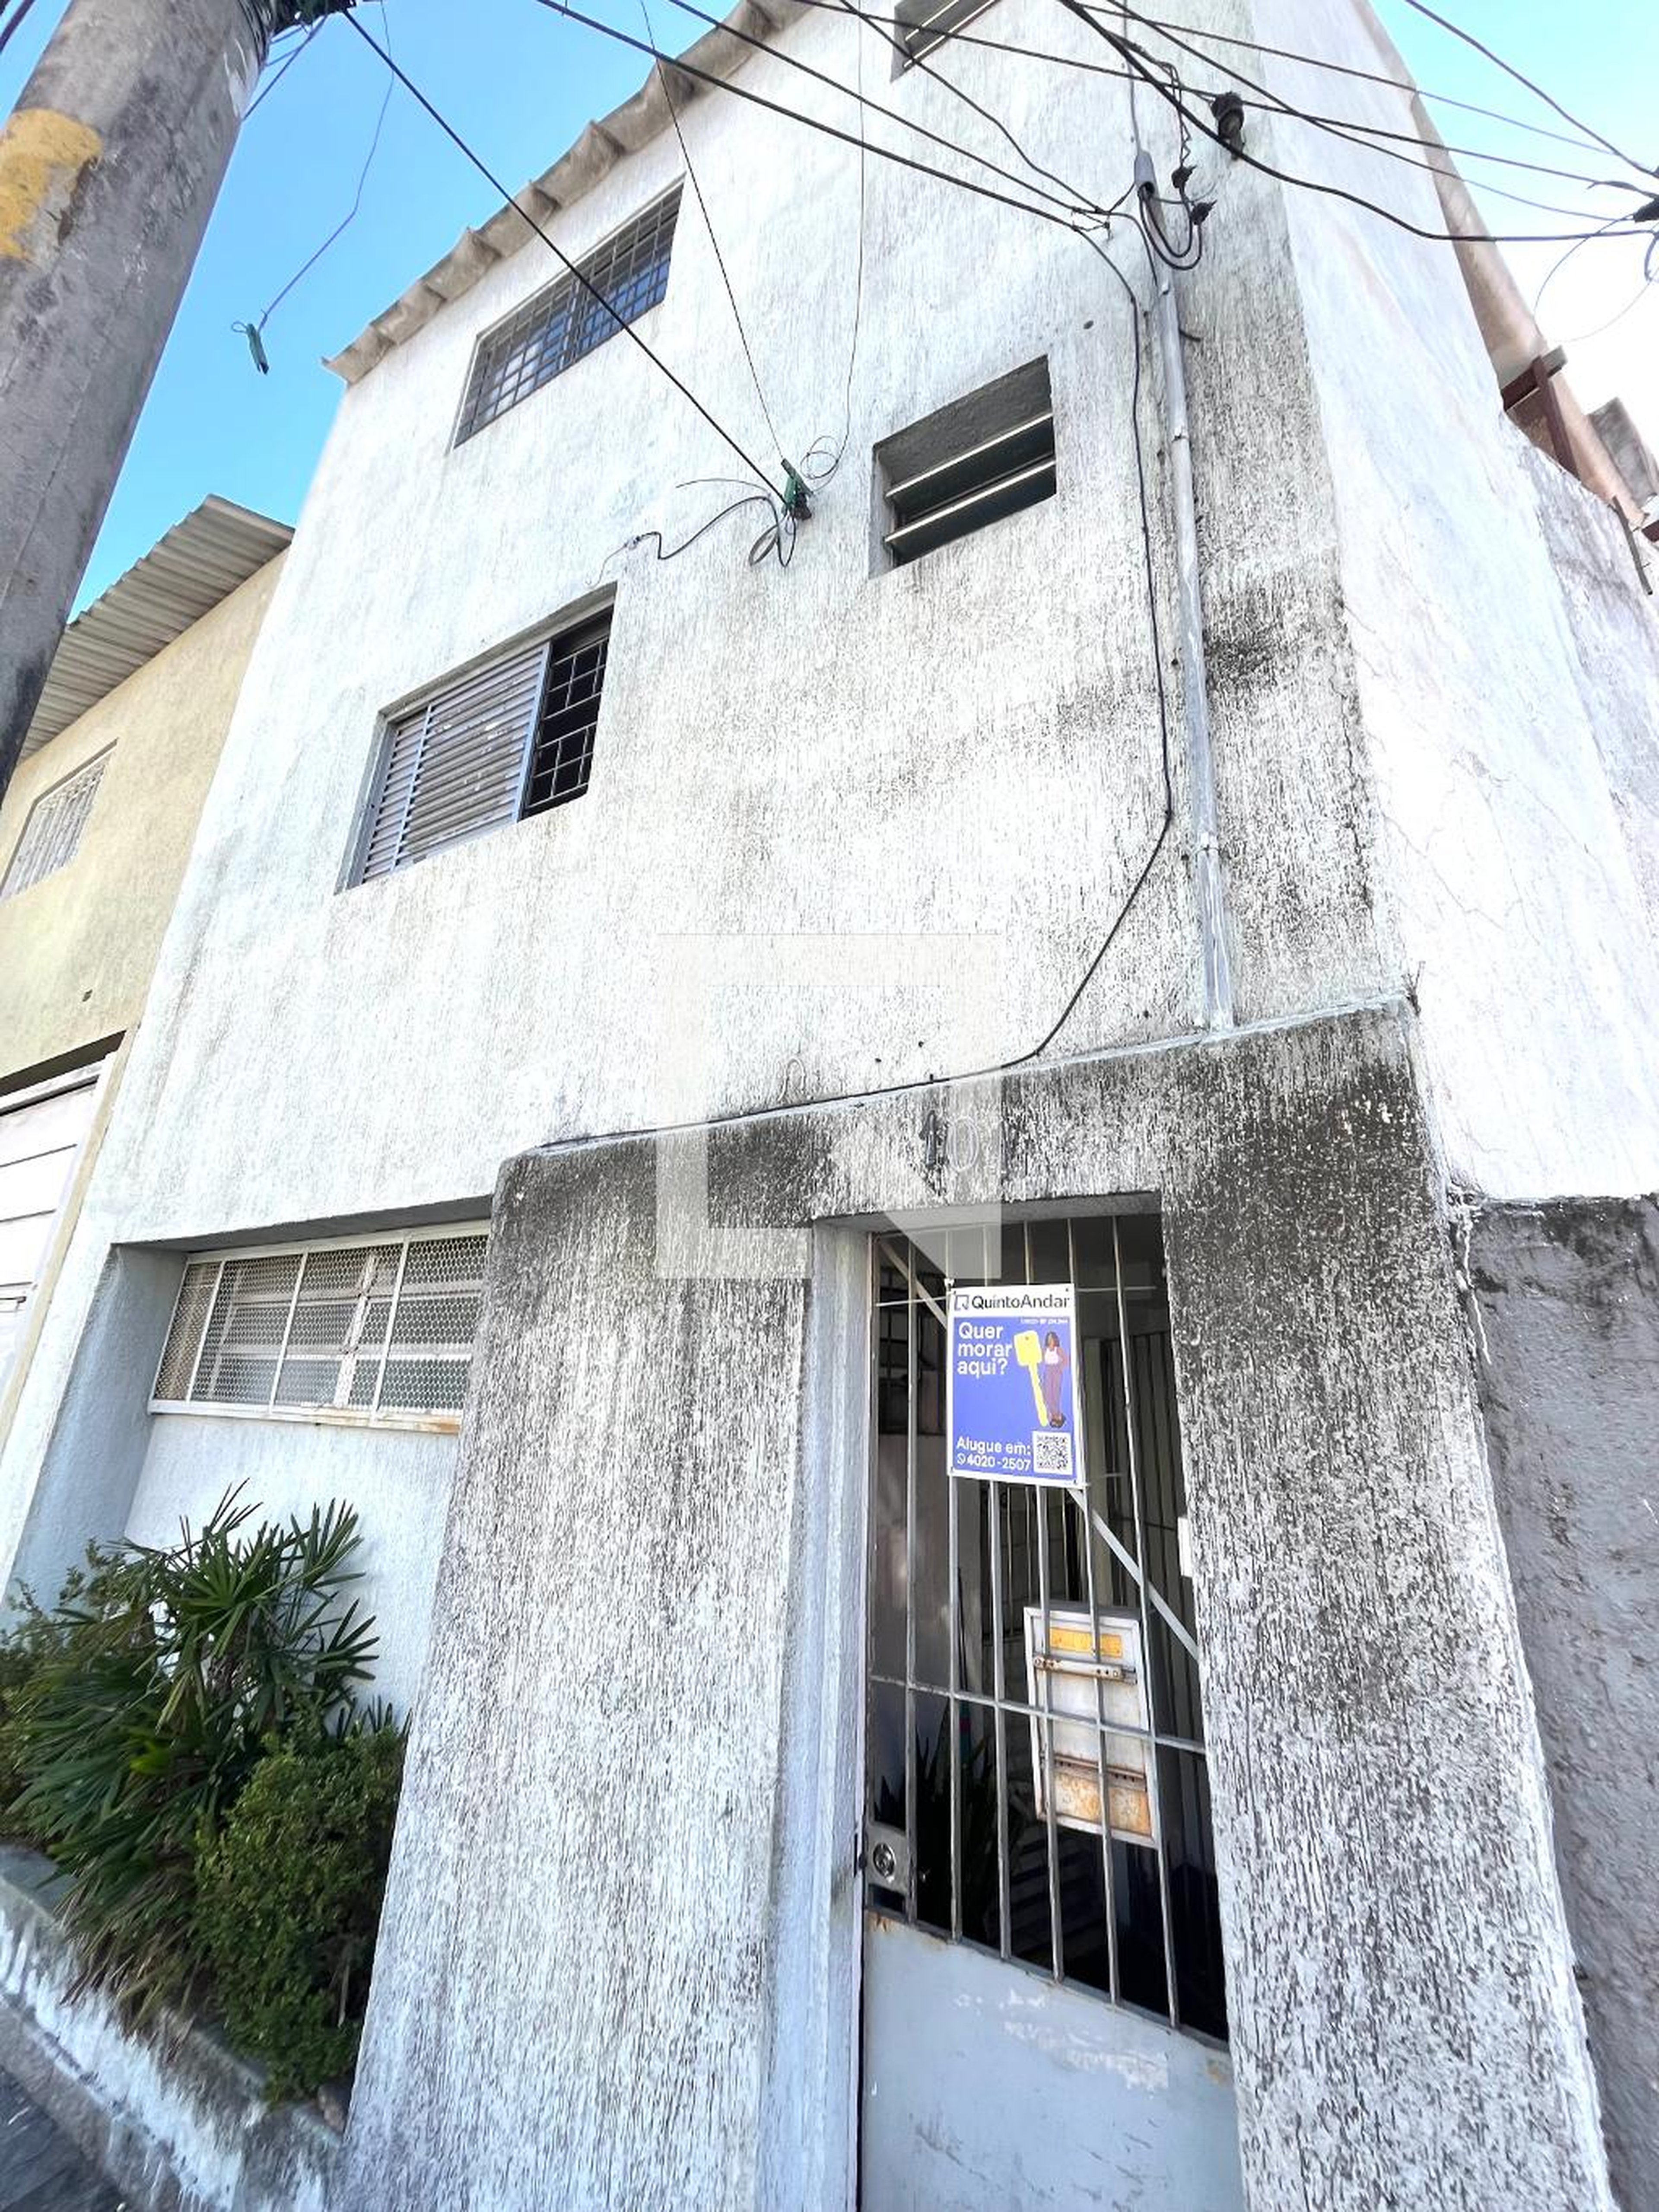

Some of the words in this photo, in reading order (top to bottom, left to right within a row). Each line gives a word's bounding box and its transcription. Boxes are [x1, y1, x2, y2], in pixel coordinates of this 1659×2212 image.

[972, 1294, 1070, 1309] QuintoAndar
[959, 1322, 1003, 1339] Quer
[958, 1343, 1012, 1357] morar
[957, 1358, 1007, 1379] aqui?
[957, 1436, 1002, 1454] Alugue
[1006, 1443, 1031, 1455] em:
